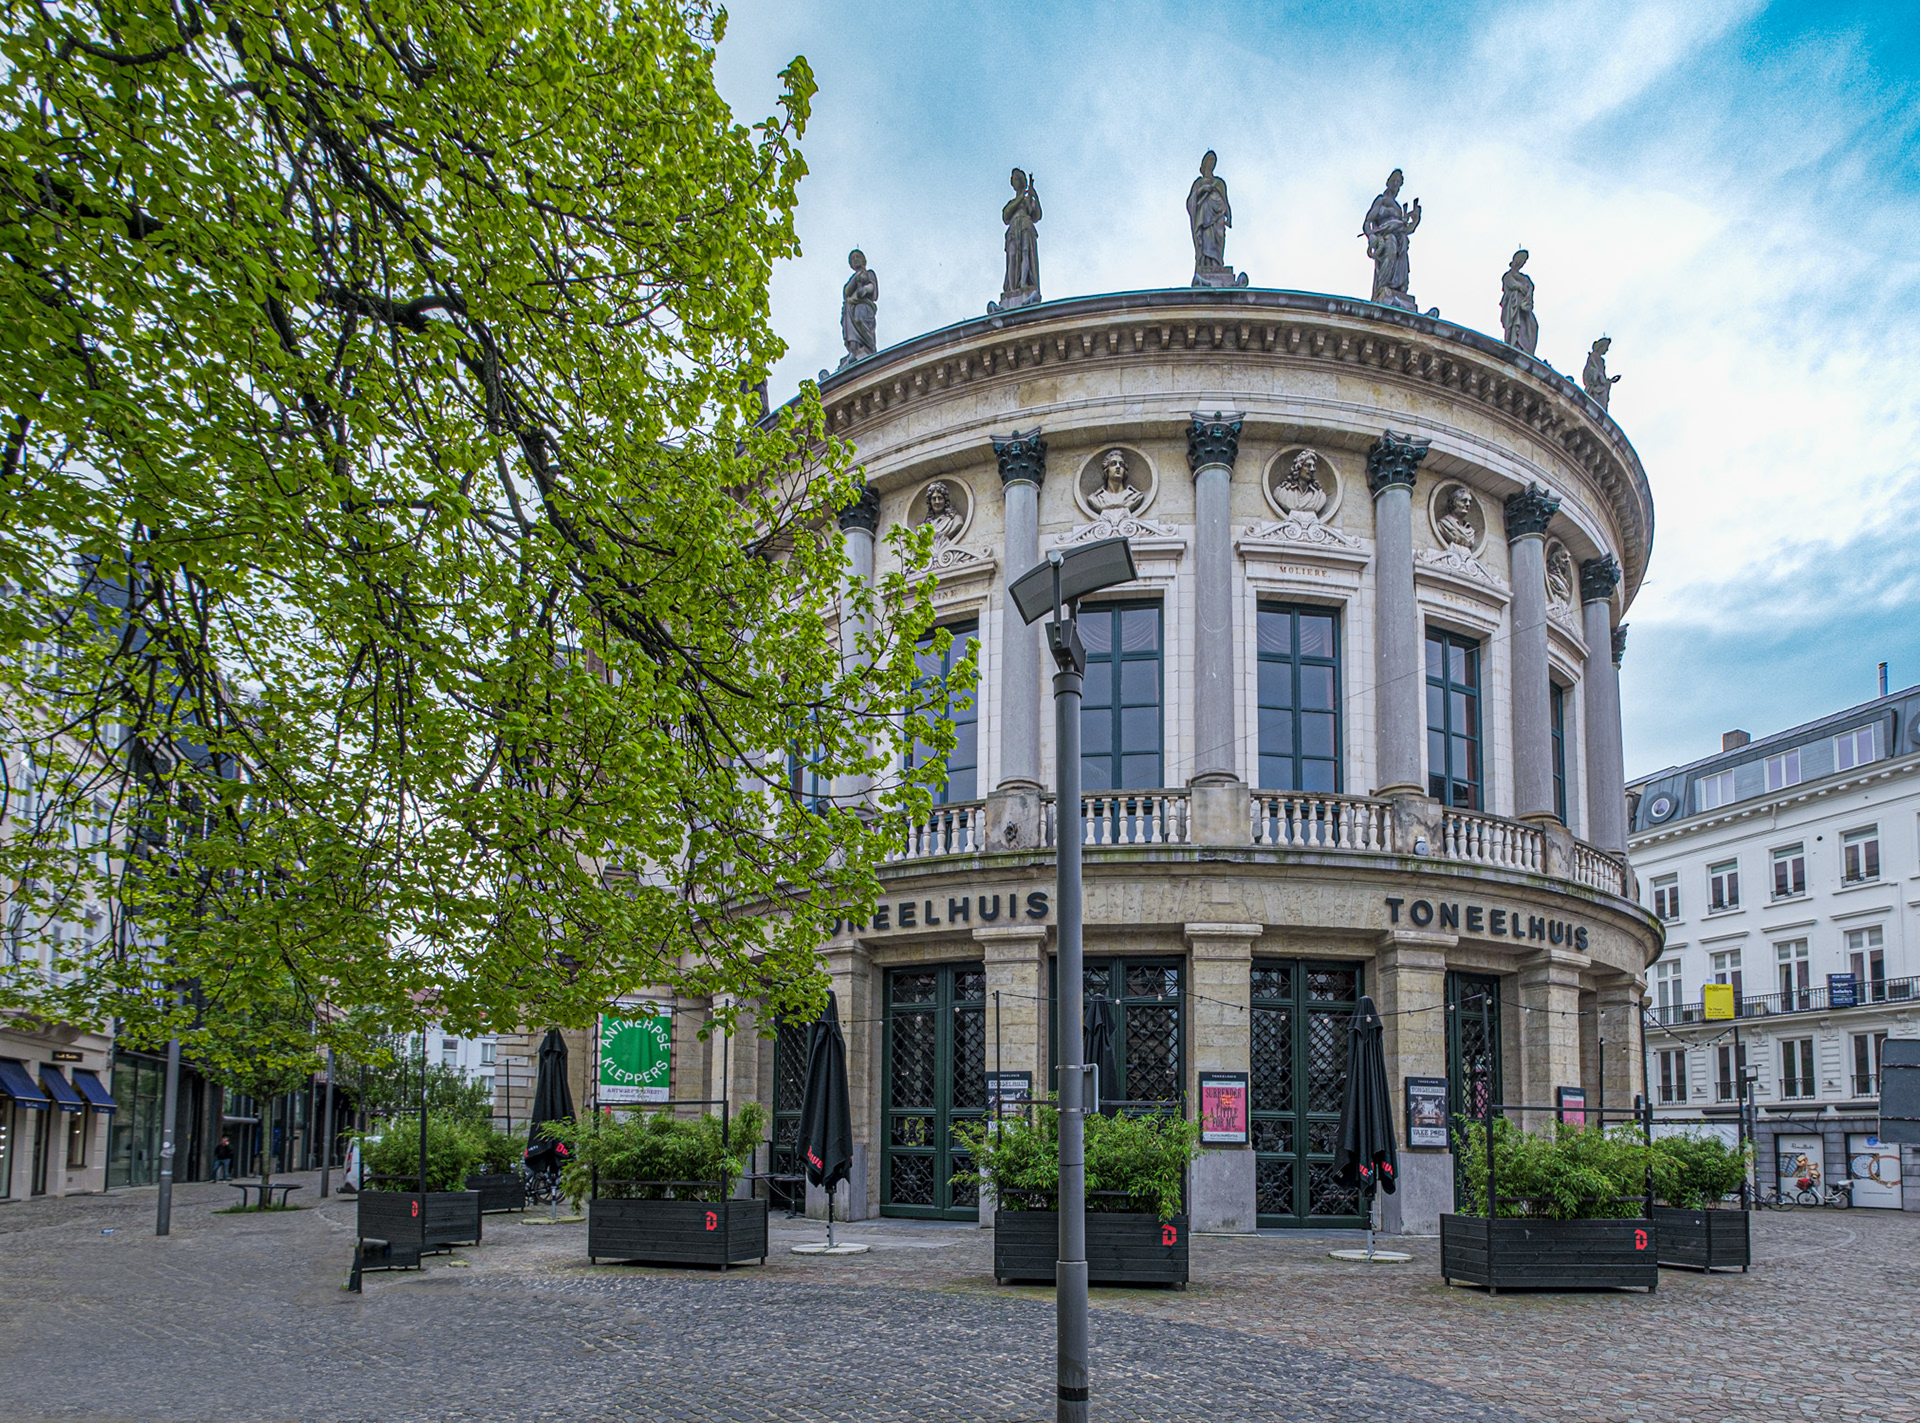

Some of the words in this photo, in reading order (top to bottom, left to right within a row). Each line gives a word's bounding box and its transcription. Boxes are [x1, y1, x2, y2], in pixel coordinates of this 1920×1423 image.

[1386, 897, 1589, 950] TONEELHUIS
[602, 1019, 671, 1051] ANTWERPSE
[601, 1057, 668, 1085] KLEPPERS
